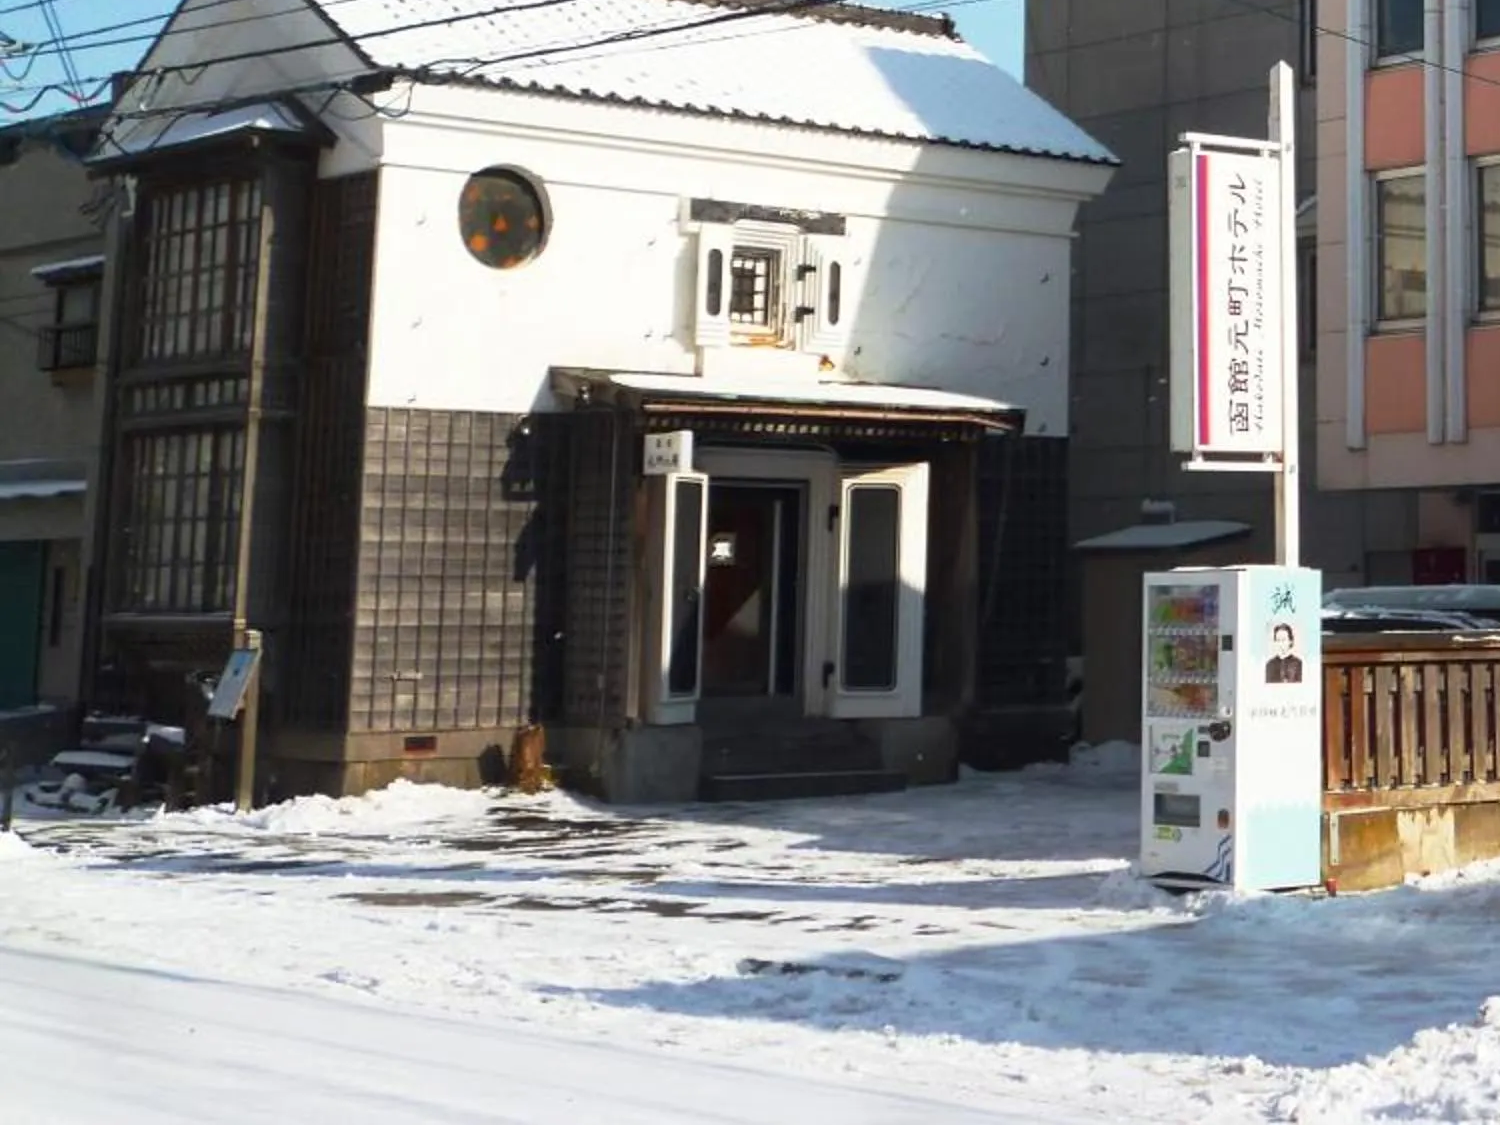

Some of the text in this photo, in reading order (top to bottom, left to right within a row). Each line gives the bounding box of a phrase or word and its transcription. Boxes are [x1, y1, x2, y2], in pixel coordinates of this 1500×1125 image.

[1227, 173, 1249, 436] 函館元町ホテル
